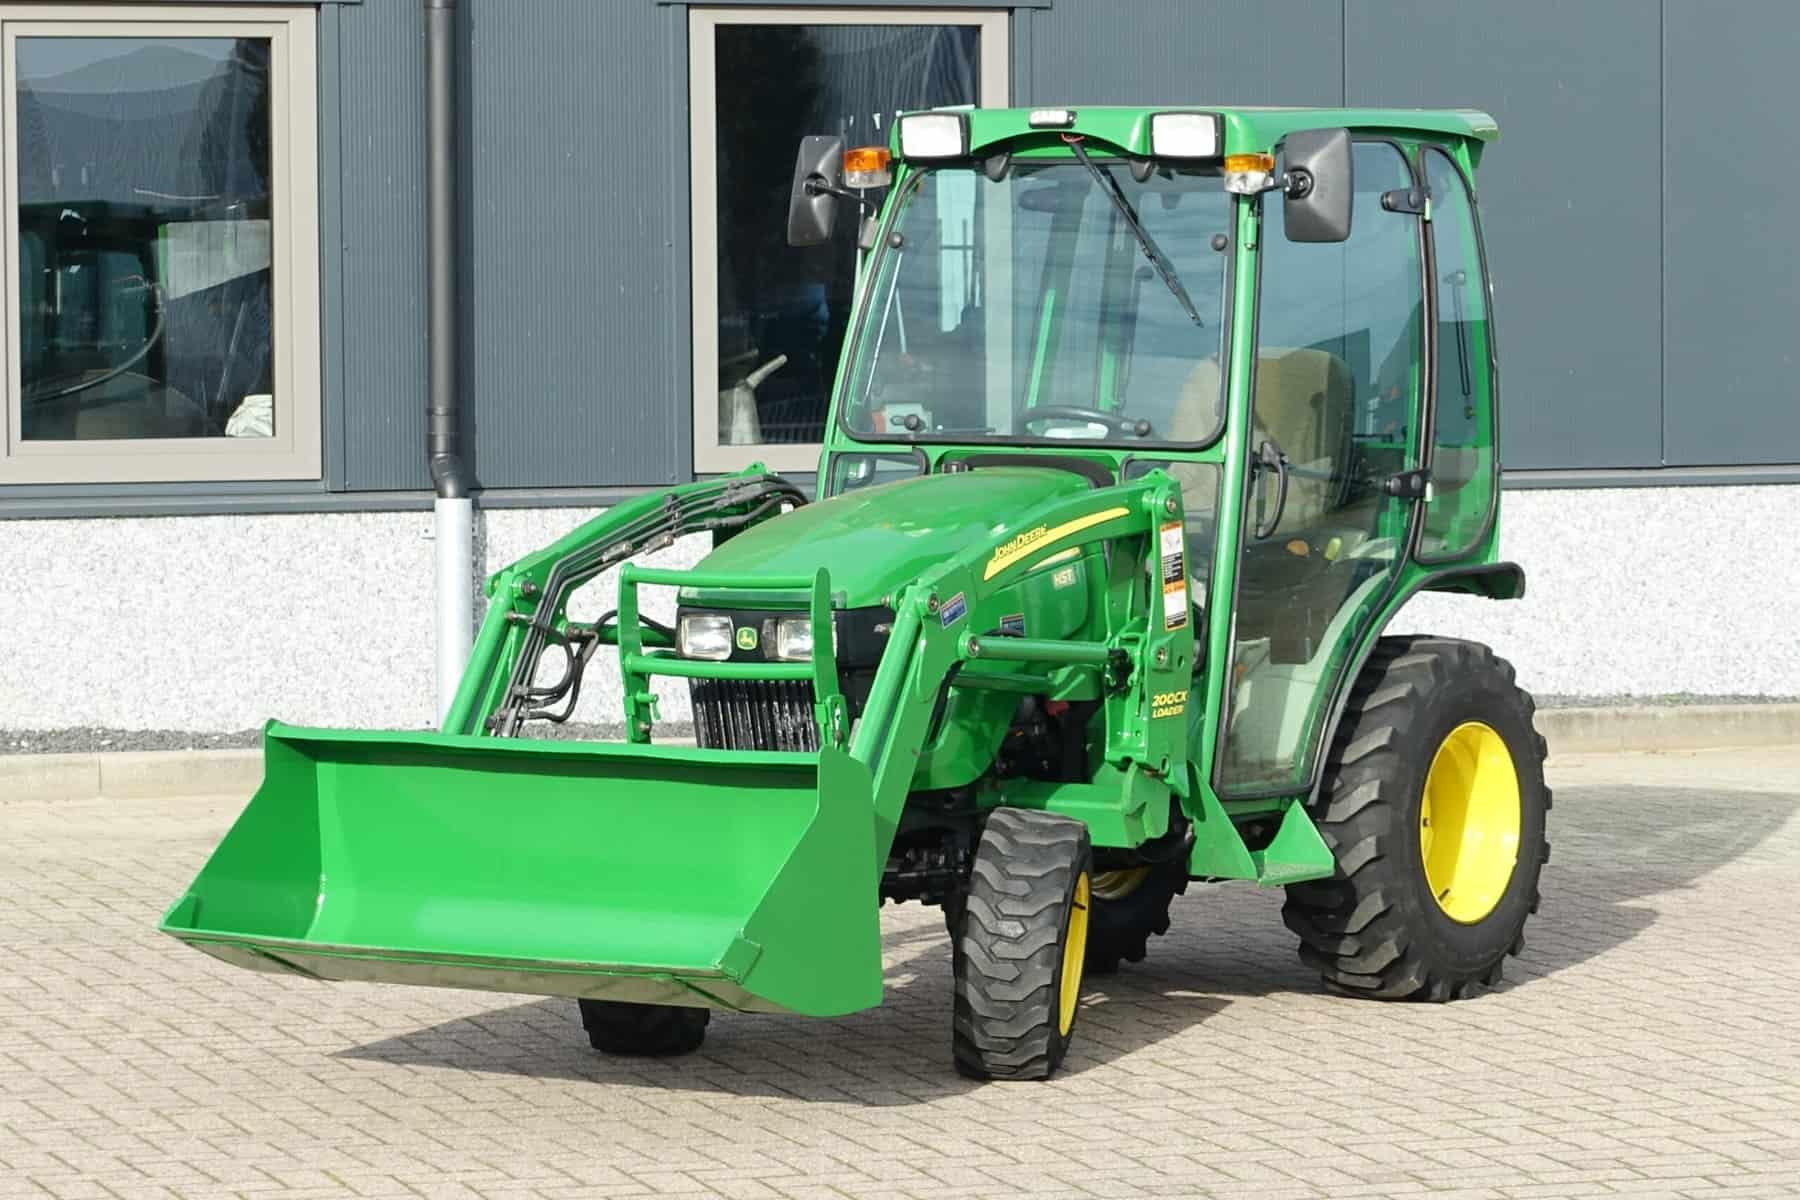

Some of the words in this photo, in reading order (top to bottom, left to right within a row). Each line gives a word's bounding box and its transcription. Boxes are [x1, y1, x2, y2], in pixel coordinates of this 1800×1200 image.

[994, 539, 1016, 561] JOHN
[1016, 527, 1047, 550] DEERE
[1152, 704, 1185, 718] LOADER
